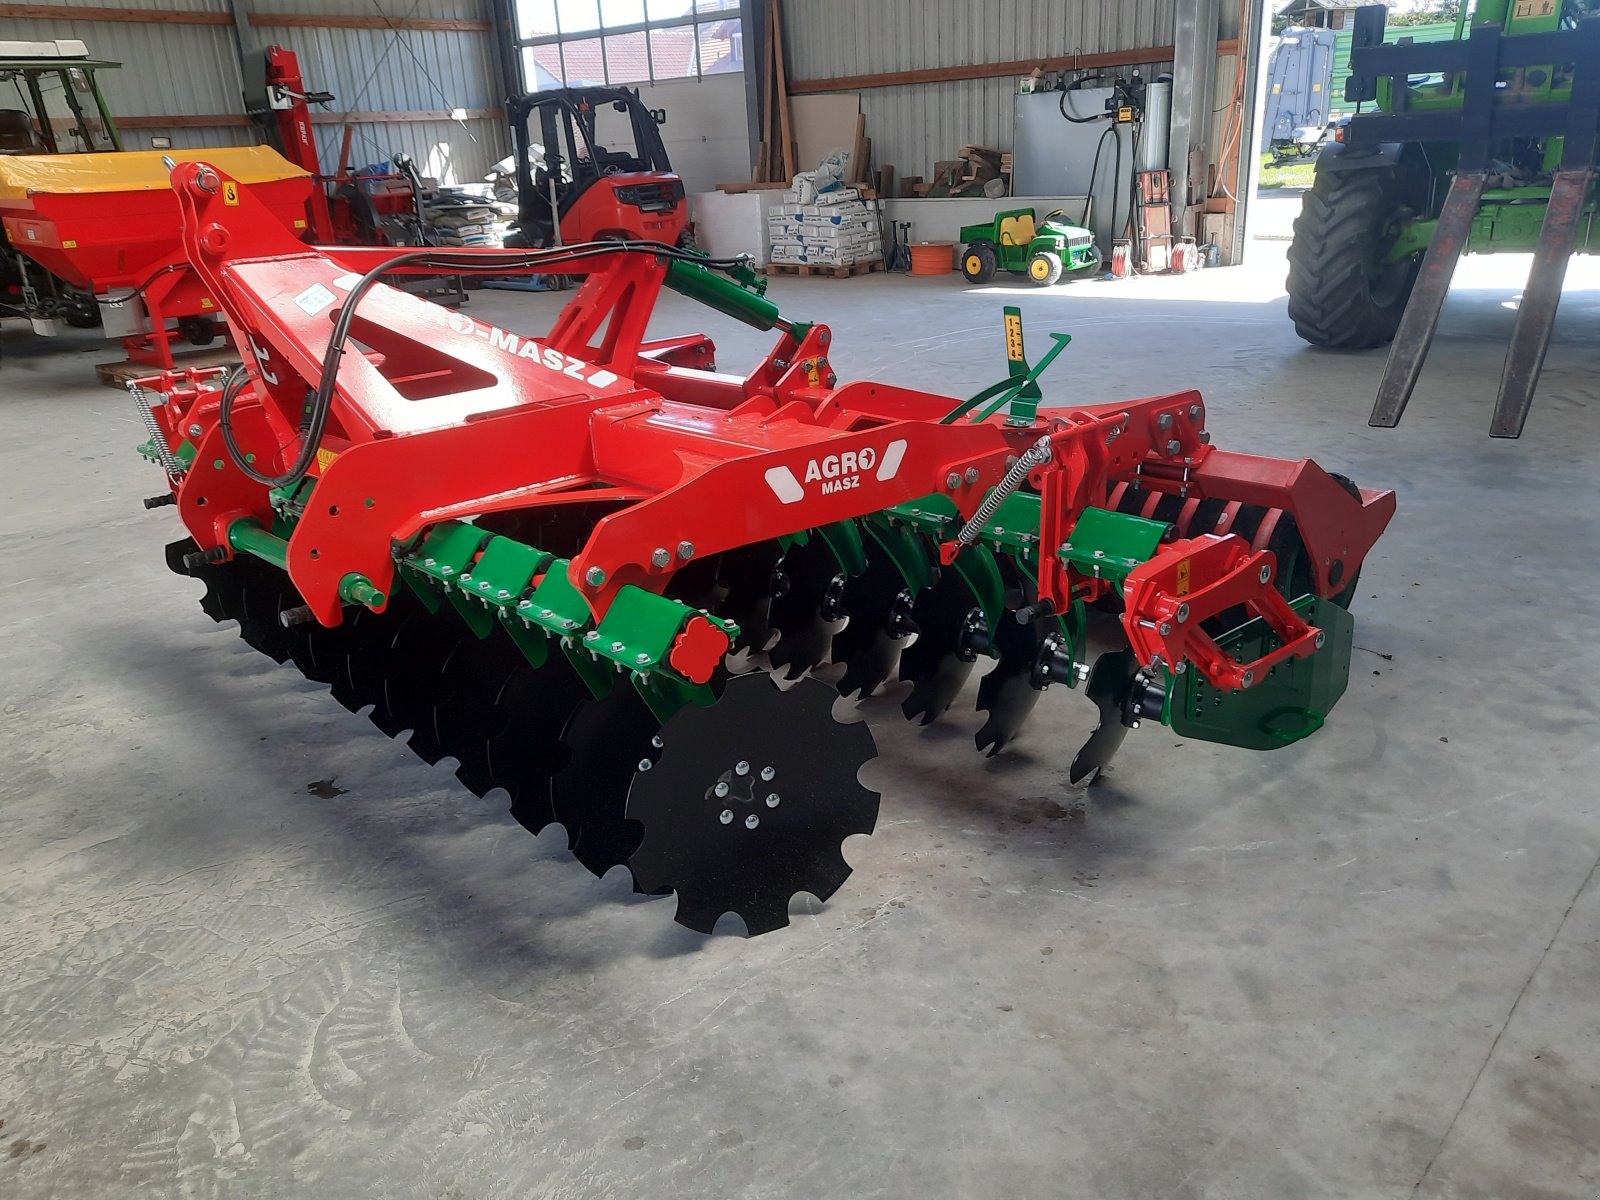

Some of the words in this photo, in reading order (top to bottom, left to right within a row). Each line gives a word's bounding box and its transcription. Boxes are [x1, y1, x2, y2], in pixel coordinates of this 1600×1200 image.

[1008, 318, 1013, 327] 1
[1010, 328, 1014, 338] 2
[1010, 339, 1015, 348] 3
[1011, 349, 1016, 358] 4
[804, 447, 876, 483] AGRO
[822, 475, 860, 495] MASZ
